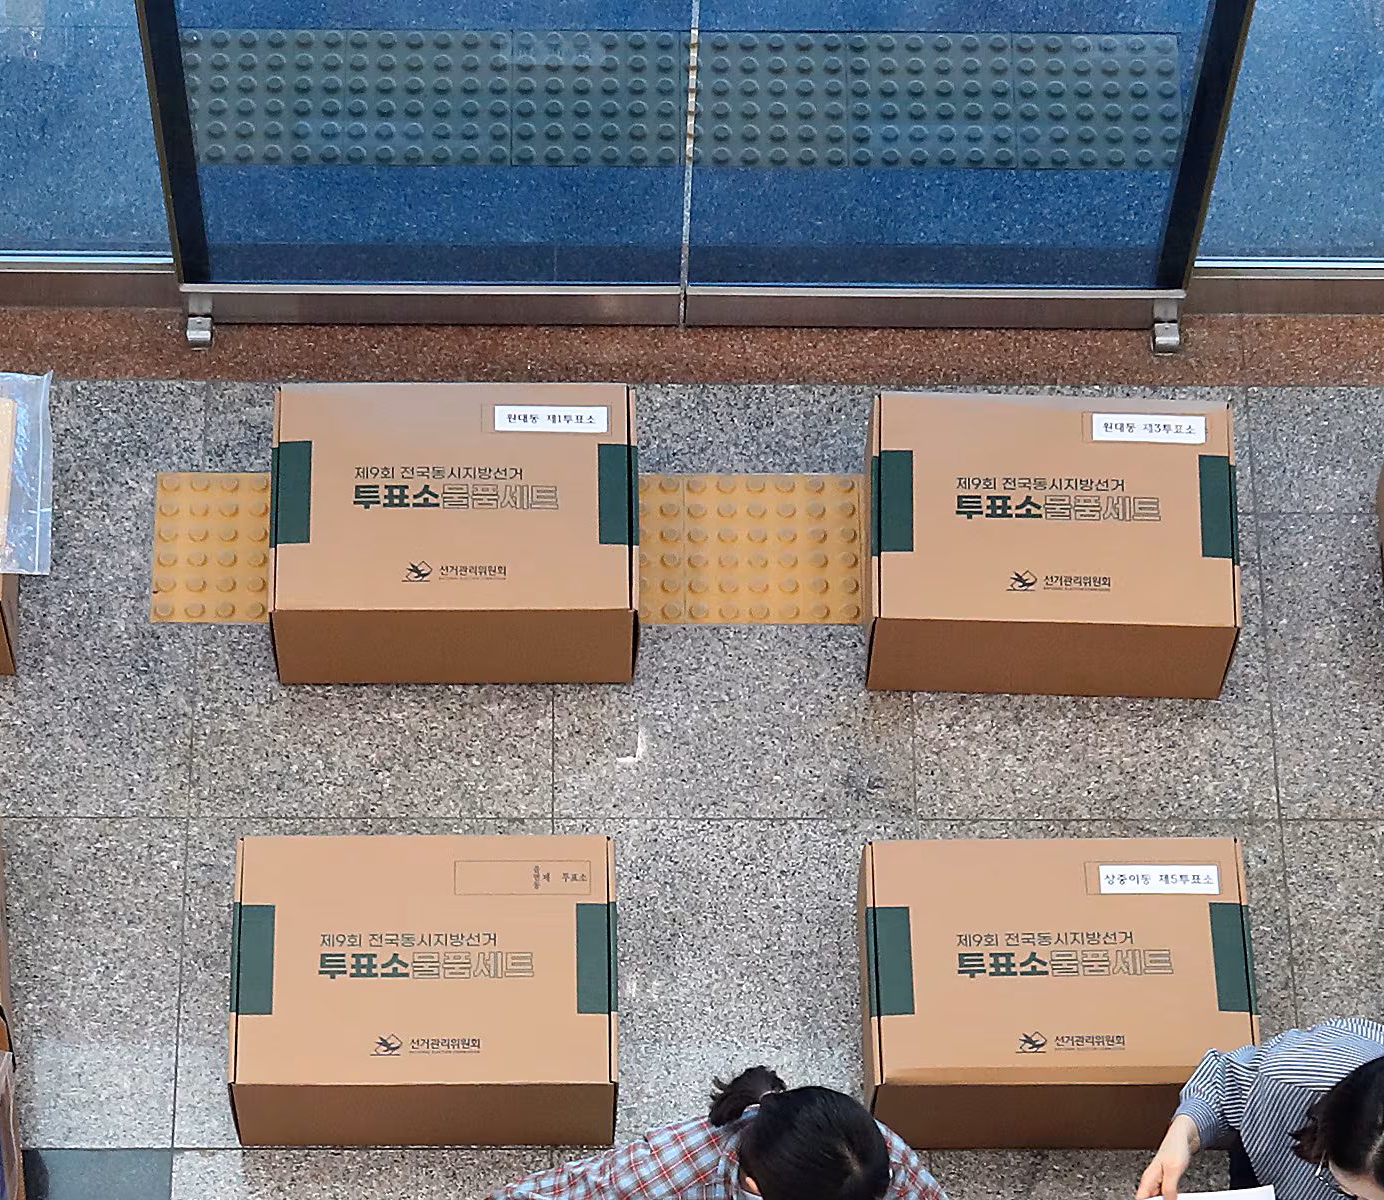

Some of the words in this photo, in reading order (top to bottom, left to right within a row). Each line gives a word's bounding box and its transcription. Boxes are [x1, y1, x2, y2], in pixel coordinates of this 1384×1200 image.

[354, 466, 395, 480] 제9회
[401, 466, 524, 480] 전국동시지방선거
[956, 477, 997, 491] 제9회
[1003, 477, 1125, 492] 전국동시지방선거
[353, 484, 559, 509] 투표소물품세트
[955, 495, 1161, 521] 투표소물품세트
[439, 565, 507, 577] 선거관리위원회
[1043, 574, 1111, 588] 선거관리위원회
[320, 933, 362, 947] 제9회
[368, 933, 498, 948] 전국동시지방선거
[957, 932, 999, 947] 제9회
[1005, 932, 1134, 946] 전국동시지방선거
[318, 952, 535, 979] 투표소물품세트
[957, 949, 1174, 977] 투표소물품세트
[410, 1037, 481, 1050] 선거관리위원회
[1054, 1034, 1126, 1047] 선거관리위원회
